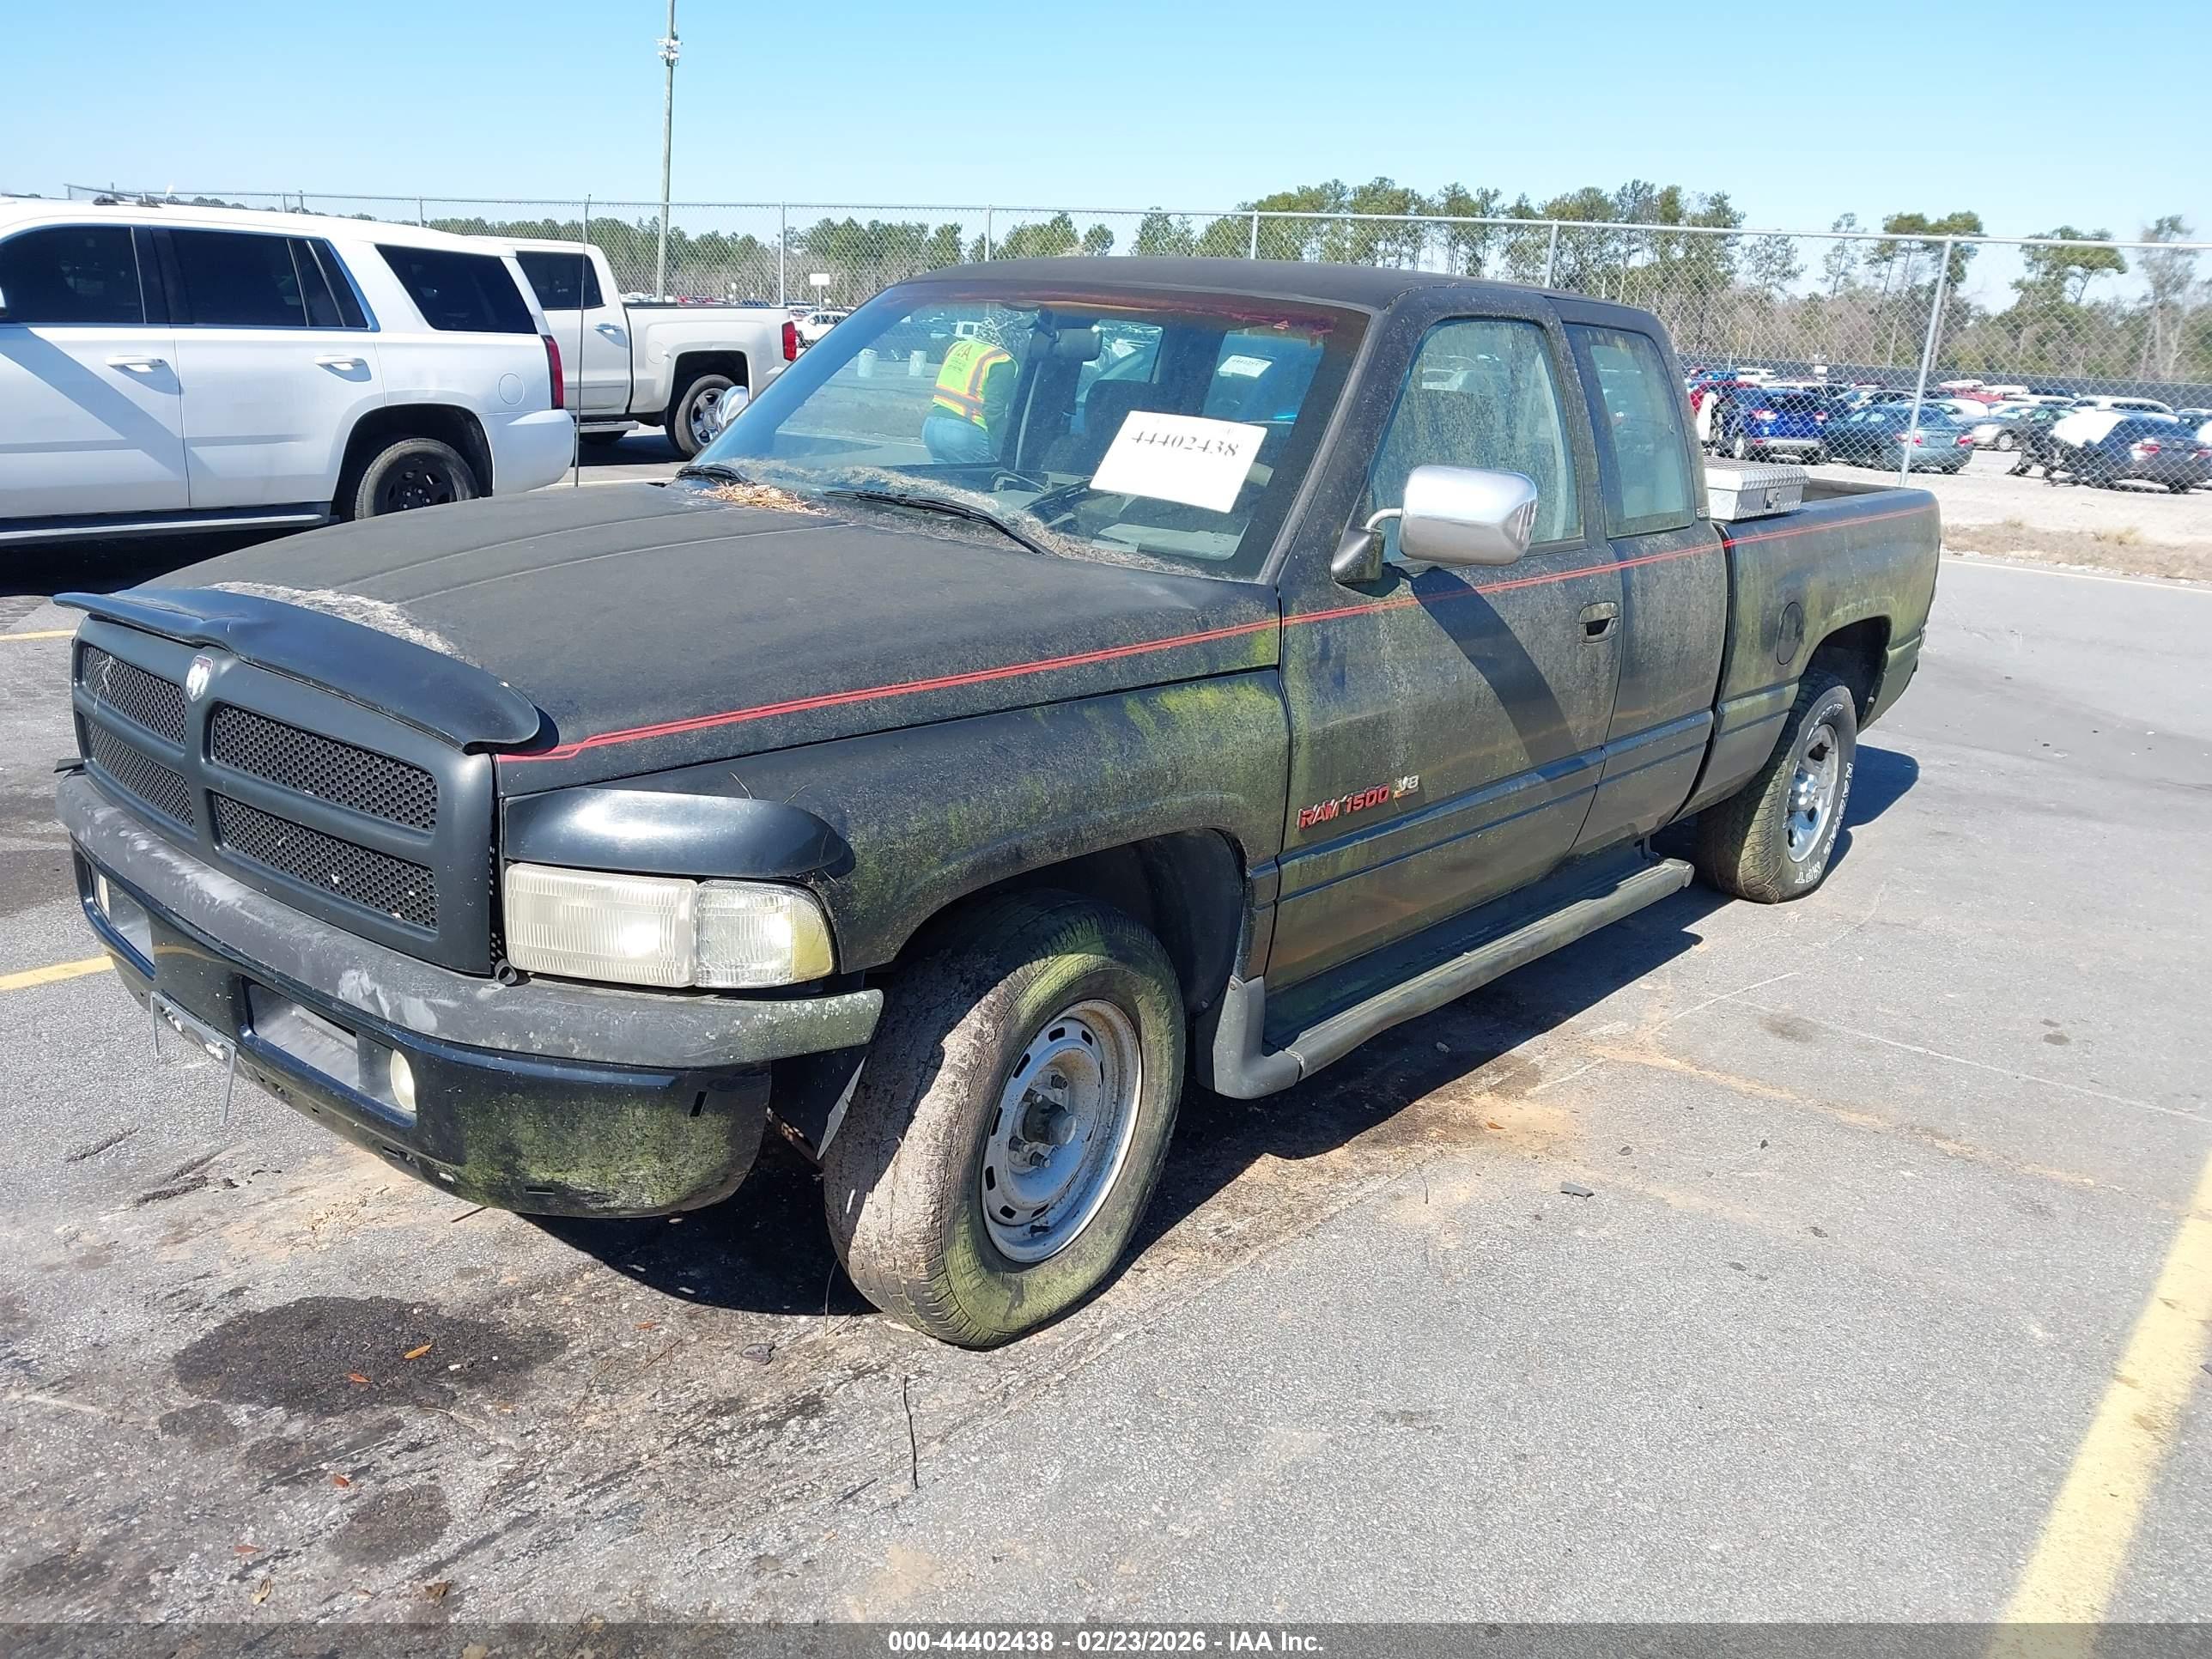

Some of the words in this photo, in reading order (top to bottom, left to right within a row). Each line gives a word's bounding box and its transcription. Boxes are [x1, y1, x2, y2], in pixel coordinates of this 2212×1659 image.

[1131, 430, 1239, 458] 44402438
[1297, 798, 1340, 832] RAM
[1345, 783, 1389, 814] 1500
[1795, 860, 1821, 884] MPT
